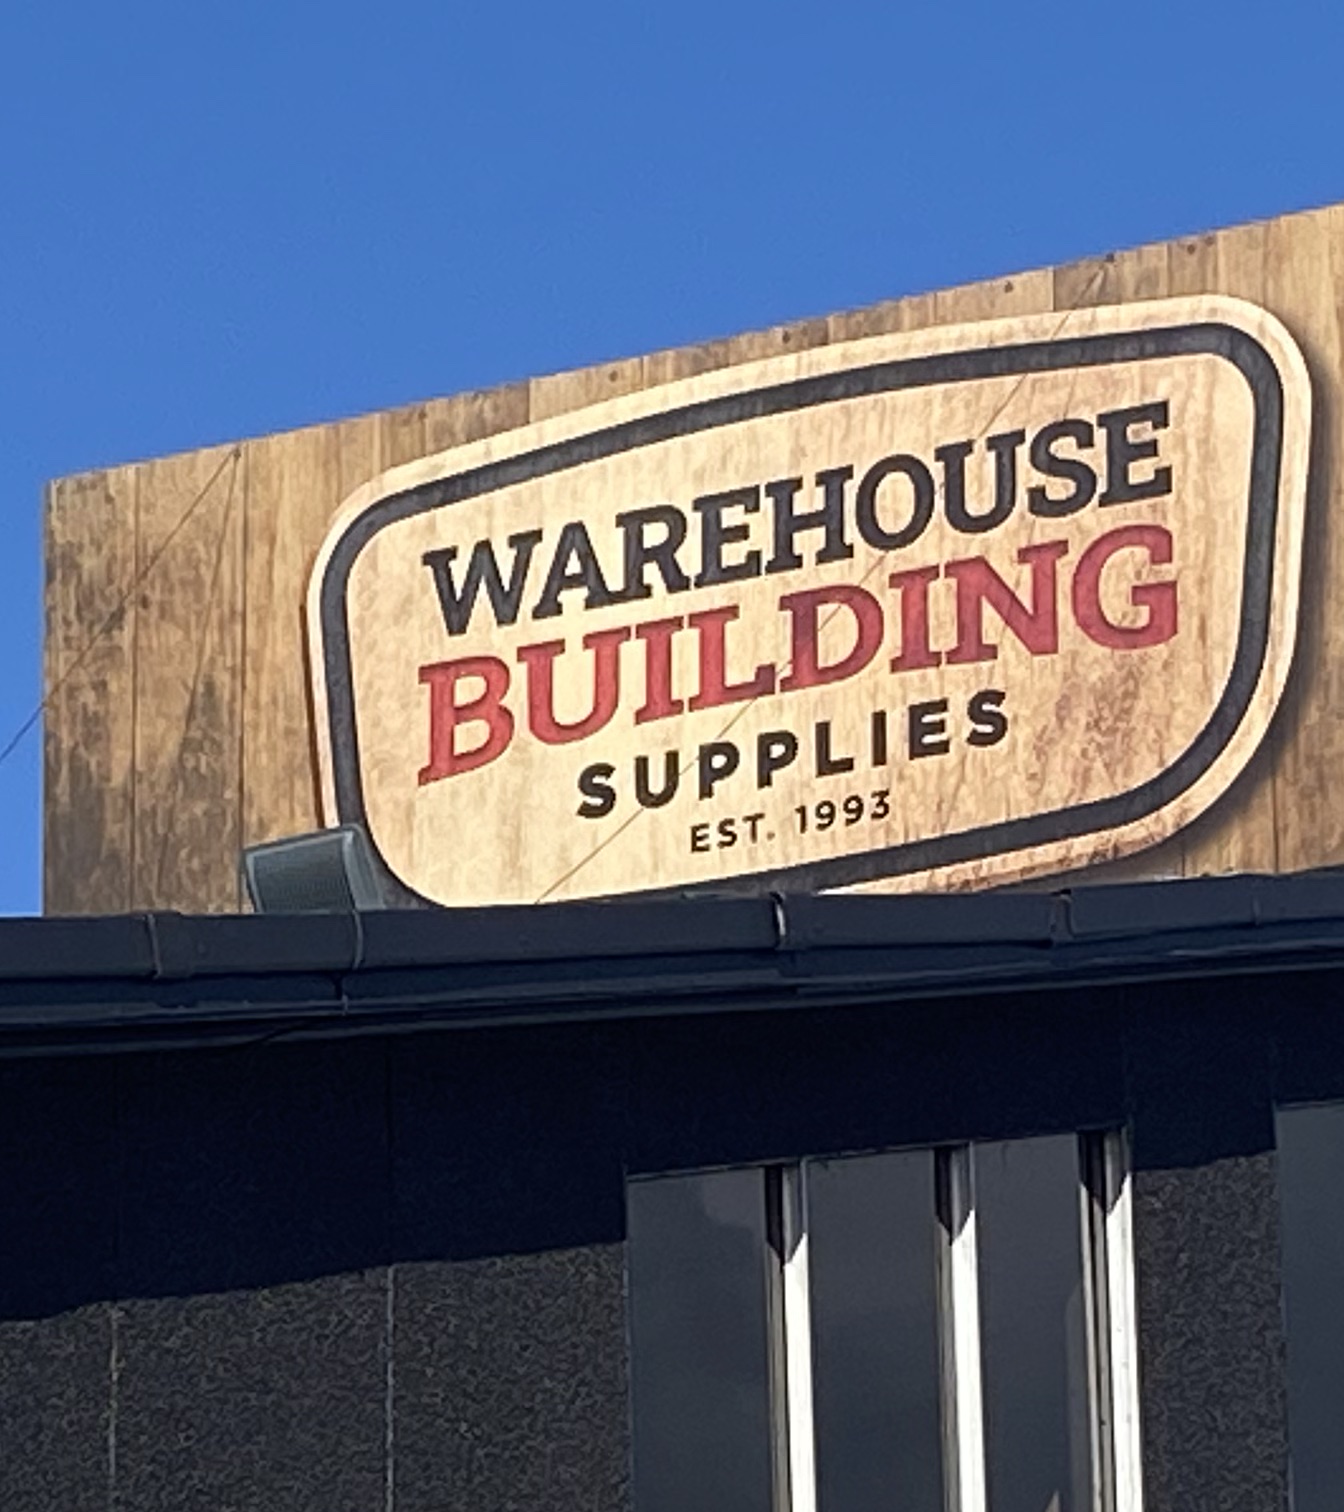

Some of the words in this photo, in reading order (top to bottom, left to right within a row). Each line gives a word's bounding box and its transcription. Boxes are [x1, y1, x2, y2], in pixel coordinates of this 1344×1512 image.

[422, 400, 1173, 637] WAREHOUSE
[417, 524, 1179, 786] BUILDING
[576, 689, 1009, 820] SUPPLIES
[689, 812, 776, 853] EST.
[794, 788, 890, 835] 1993
